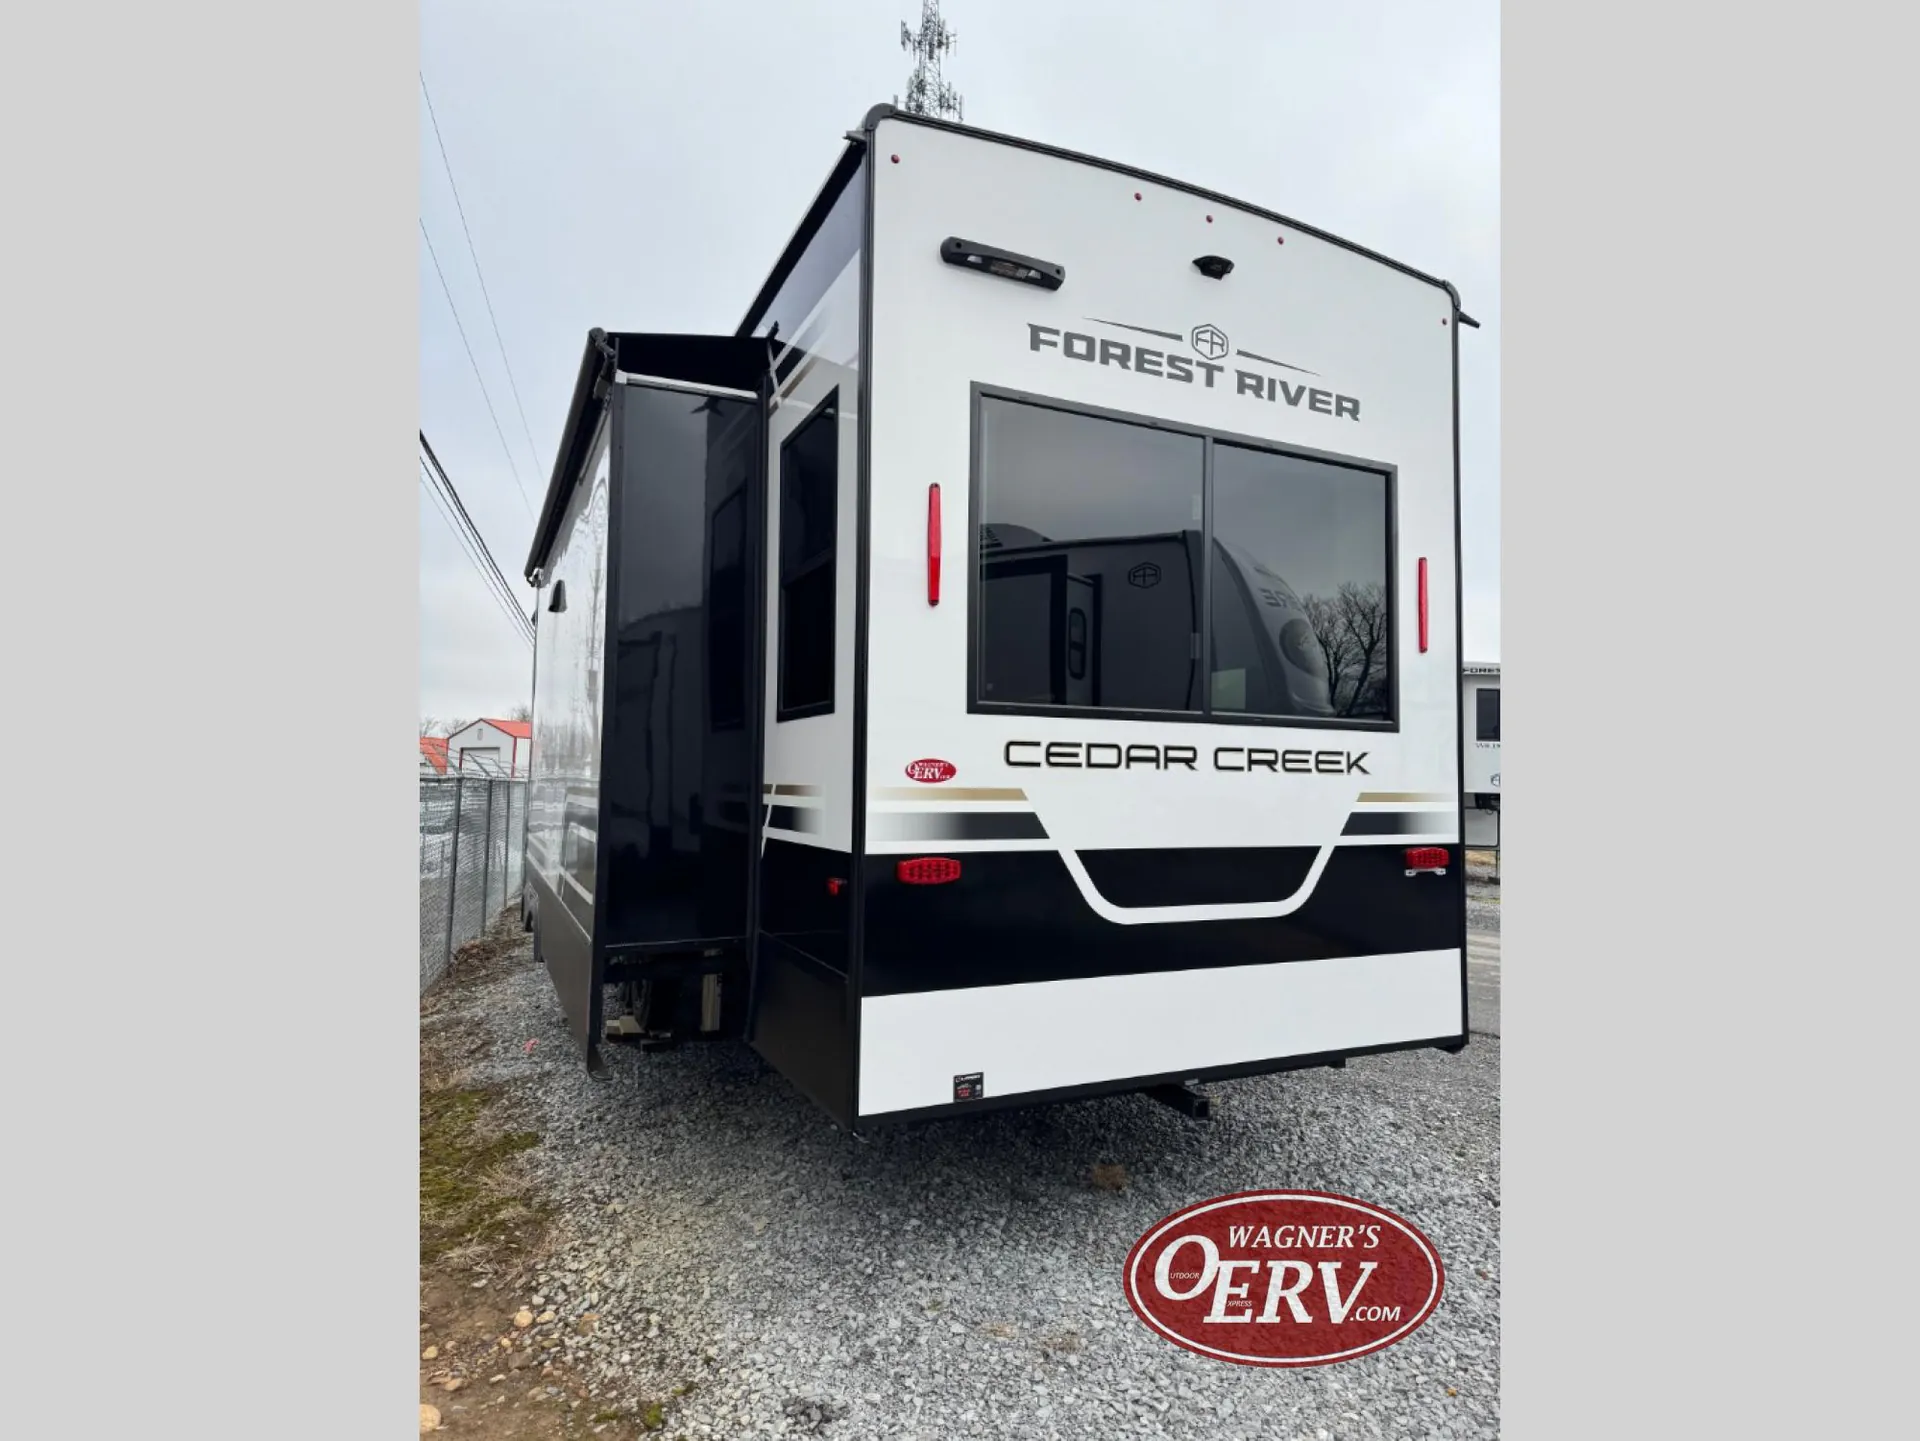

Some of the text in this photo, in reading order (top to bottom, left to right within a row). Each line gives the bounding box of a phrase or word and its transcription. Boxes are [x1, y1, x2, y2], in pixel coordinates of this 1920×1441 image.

[1027, 322, 1360, 421] FOREST RIVER
[1004, 740, 1371, 775] CEDAR CREEK
